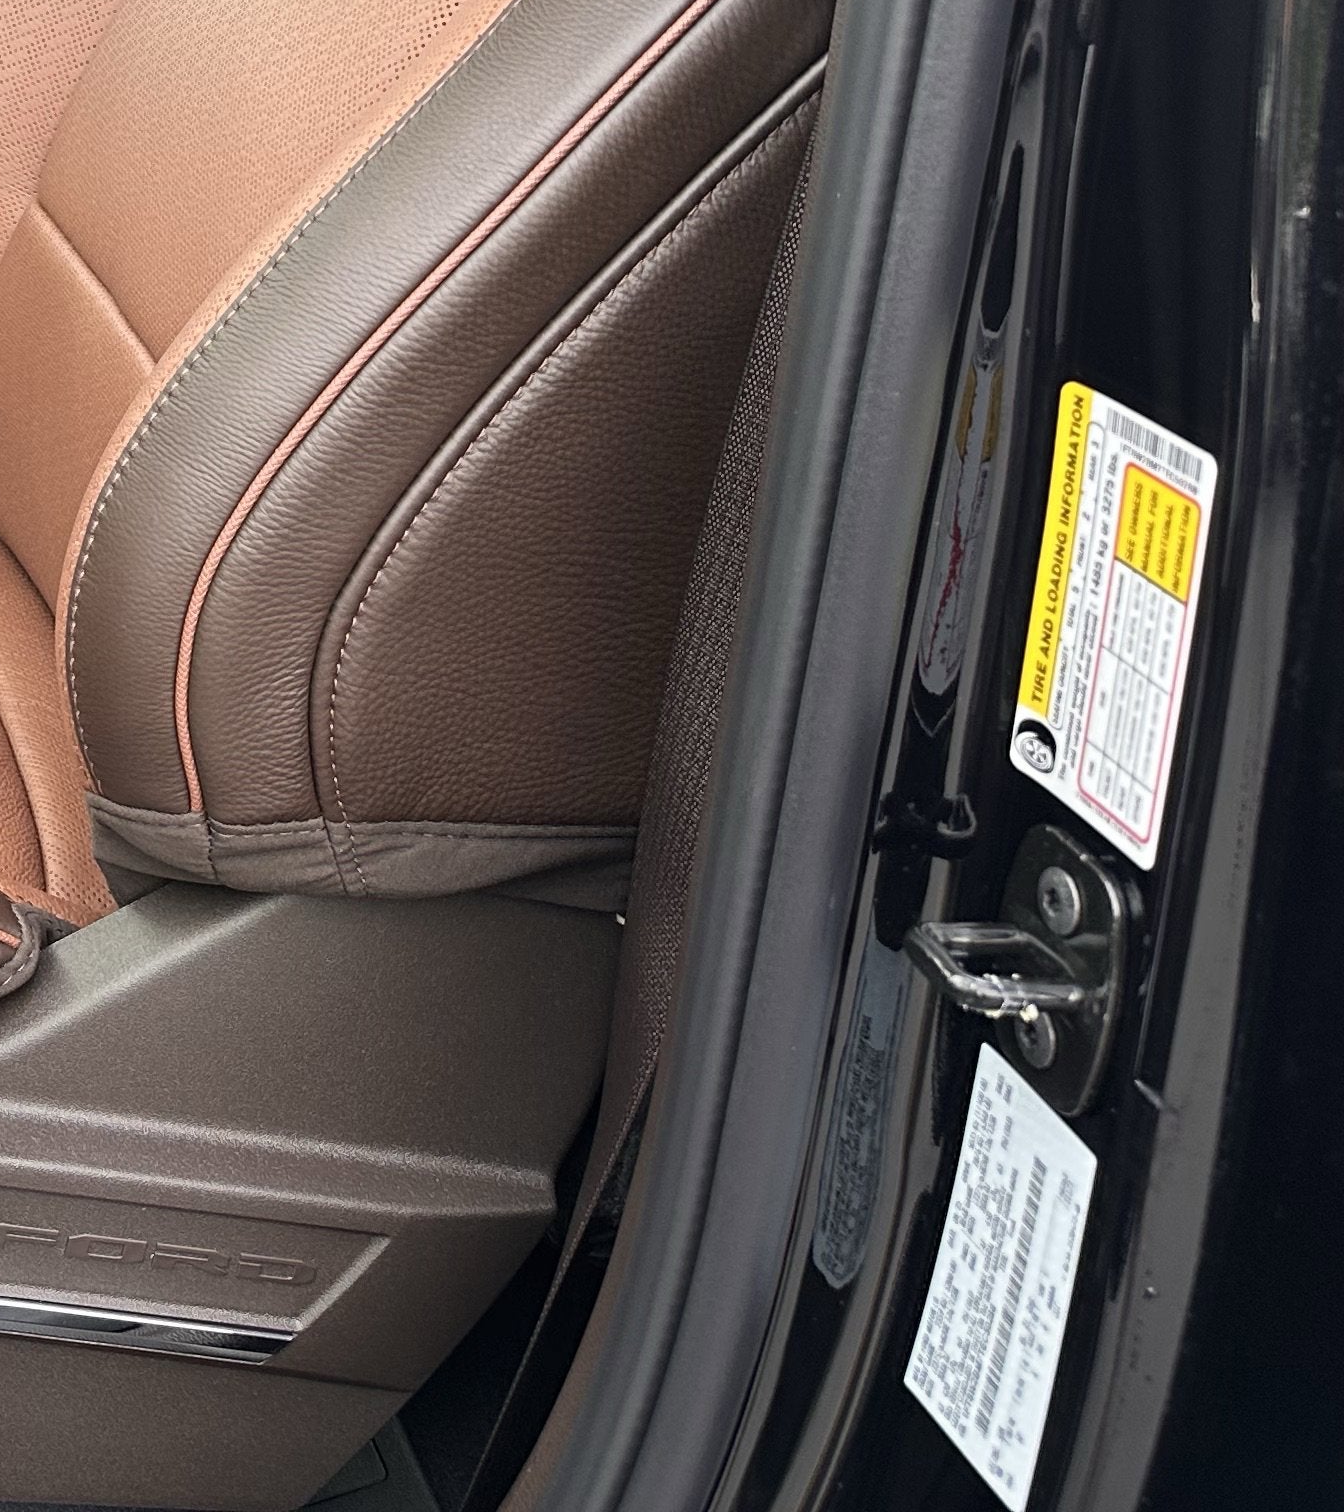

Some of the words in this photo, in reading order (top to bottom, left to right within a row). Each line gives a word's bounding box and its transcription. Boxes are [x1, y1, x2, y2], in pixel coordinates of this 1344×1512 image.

[1055, 392, 1086, 527] INFORMATION
[1101, 477, 1115, 517] 3275
[1127, 480, 1144, 536] OWNERS
[1095, 536, 1108, 560] kg
[1123, 536, 1135, 563] SEE
[1139, 518, 1155, 573] MANUAL
[1147, 488, 1159, 517] FOR
[1155, 501, 1175, 579] ADDITIONAL
[1169, 502, 1192, 594] INFORMATION
[1044, 527, 1067, 615] LOADING
[1038, 614, 1053, 659] AND
[1031, 659, 1047, 707] TIRE
